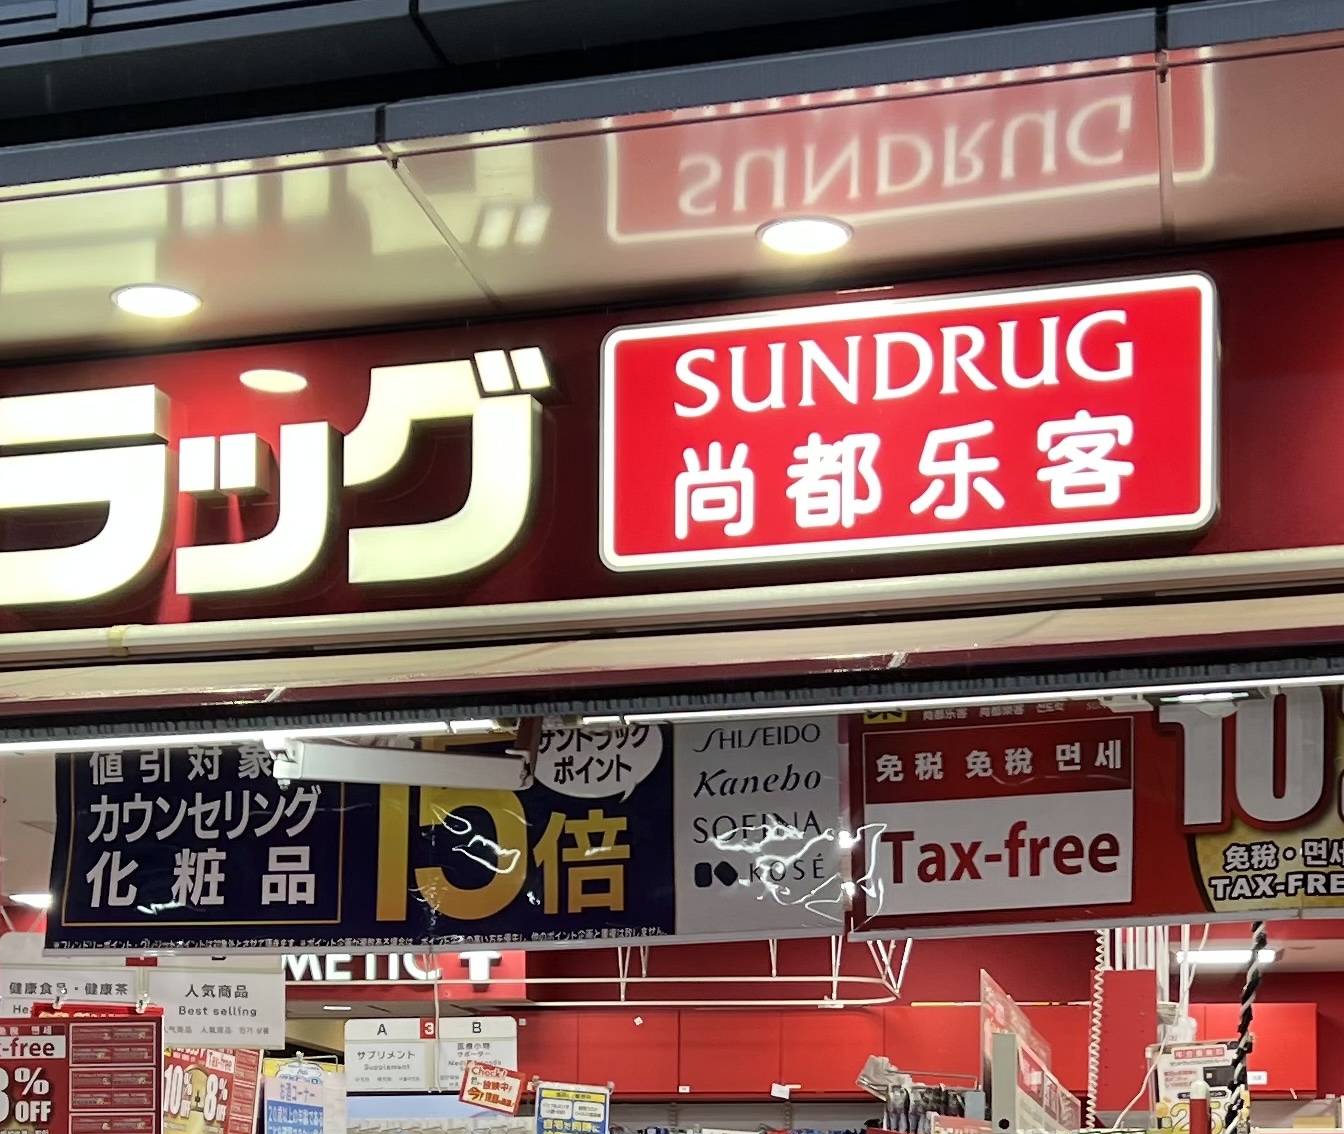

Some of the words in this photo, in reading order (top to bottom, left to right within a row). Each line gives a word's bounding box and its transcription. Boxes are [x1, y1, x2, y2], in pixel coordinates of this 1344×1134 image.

[673, 309, 1134, 418] SUNDRUG
[674, 411, 1135, 540] 尚都乐客
[693, 722, 821, 753] SHISEIDO
[89, 746, 272, 785] 値引対象
[554, 755, 632, 784] ポイント
[1055, 739, 1122, 772] 면세
[693, 764, 822, 799] Kanebo
[87, 784, 322, 842] カウンセリング
[693, 810, 822, 844] SOFINA
[748, 853, 825, 883] KOSÉ
[880, 820, 1121, 885] Tax-free
[86, 846, 315, 908] 化粧品
[185, 984, 249, 999] 人気商品
[179, 1006, 208, 1016] Best
[212, 1006, 257, 1018] selling
[377, 1023, 387, 1036] A
[424, 1022, 435, 1035] 3
[472, 1022, 482, 1034] B
[357, 1050, 416, 1060] サプリメント
